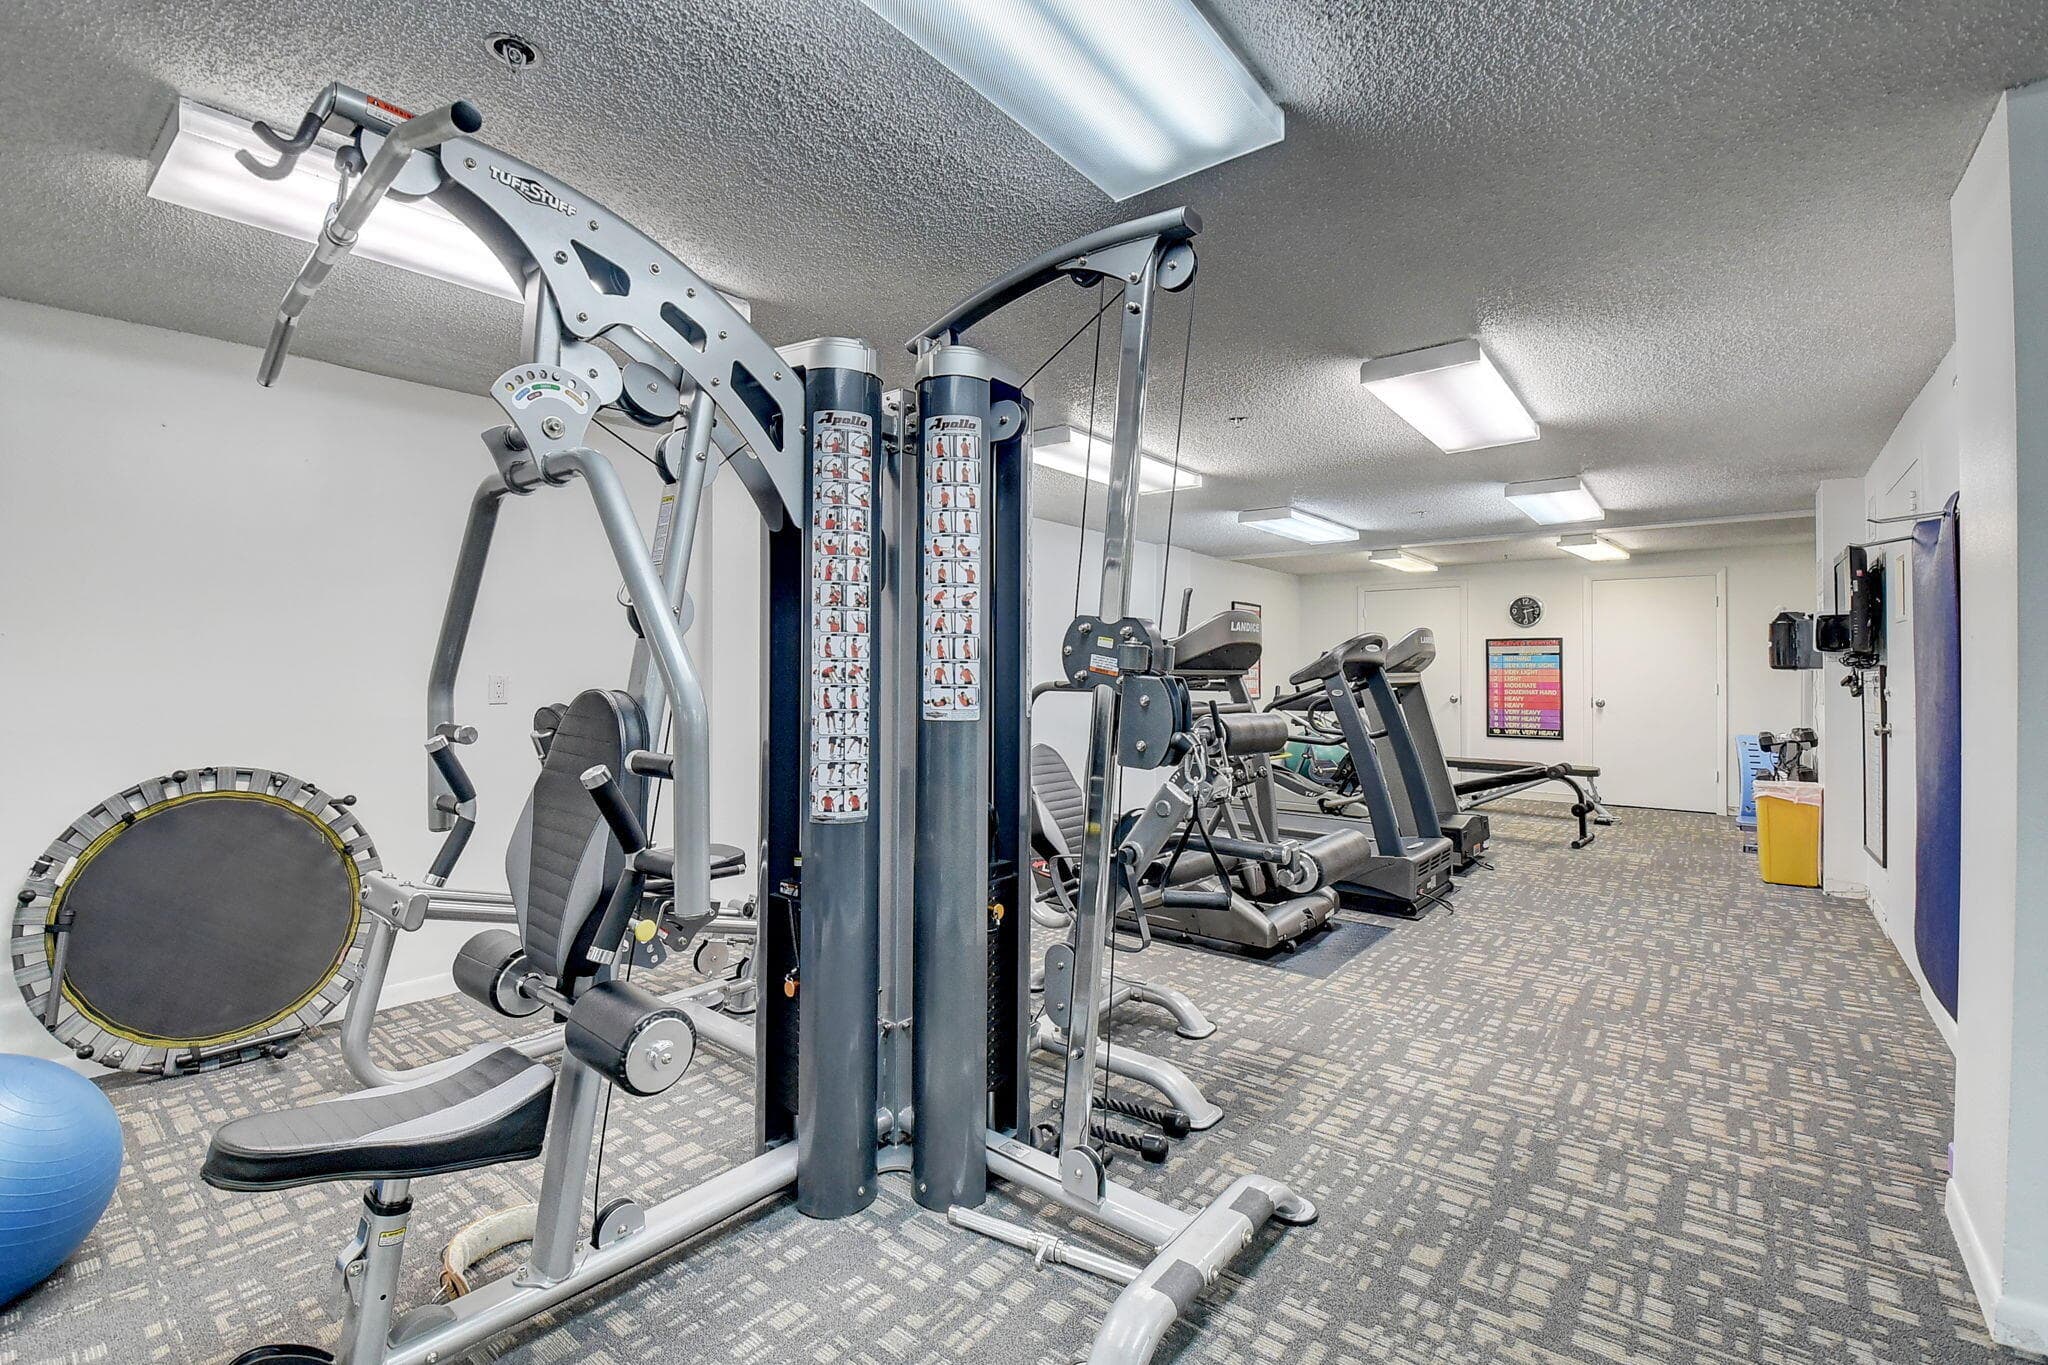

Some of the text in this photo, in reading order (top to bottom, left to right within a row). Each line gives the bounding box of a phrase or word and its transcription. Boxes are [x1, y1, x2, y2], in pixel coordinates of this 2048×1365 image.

[818, 412, 867, 428] Apollo
[929, 417, 977, 430] Apollo
[1231, 621, 1260, 632] LANDICE
